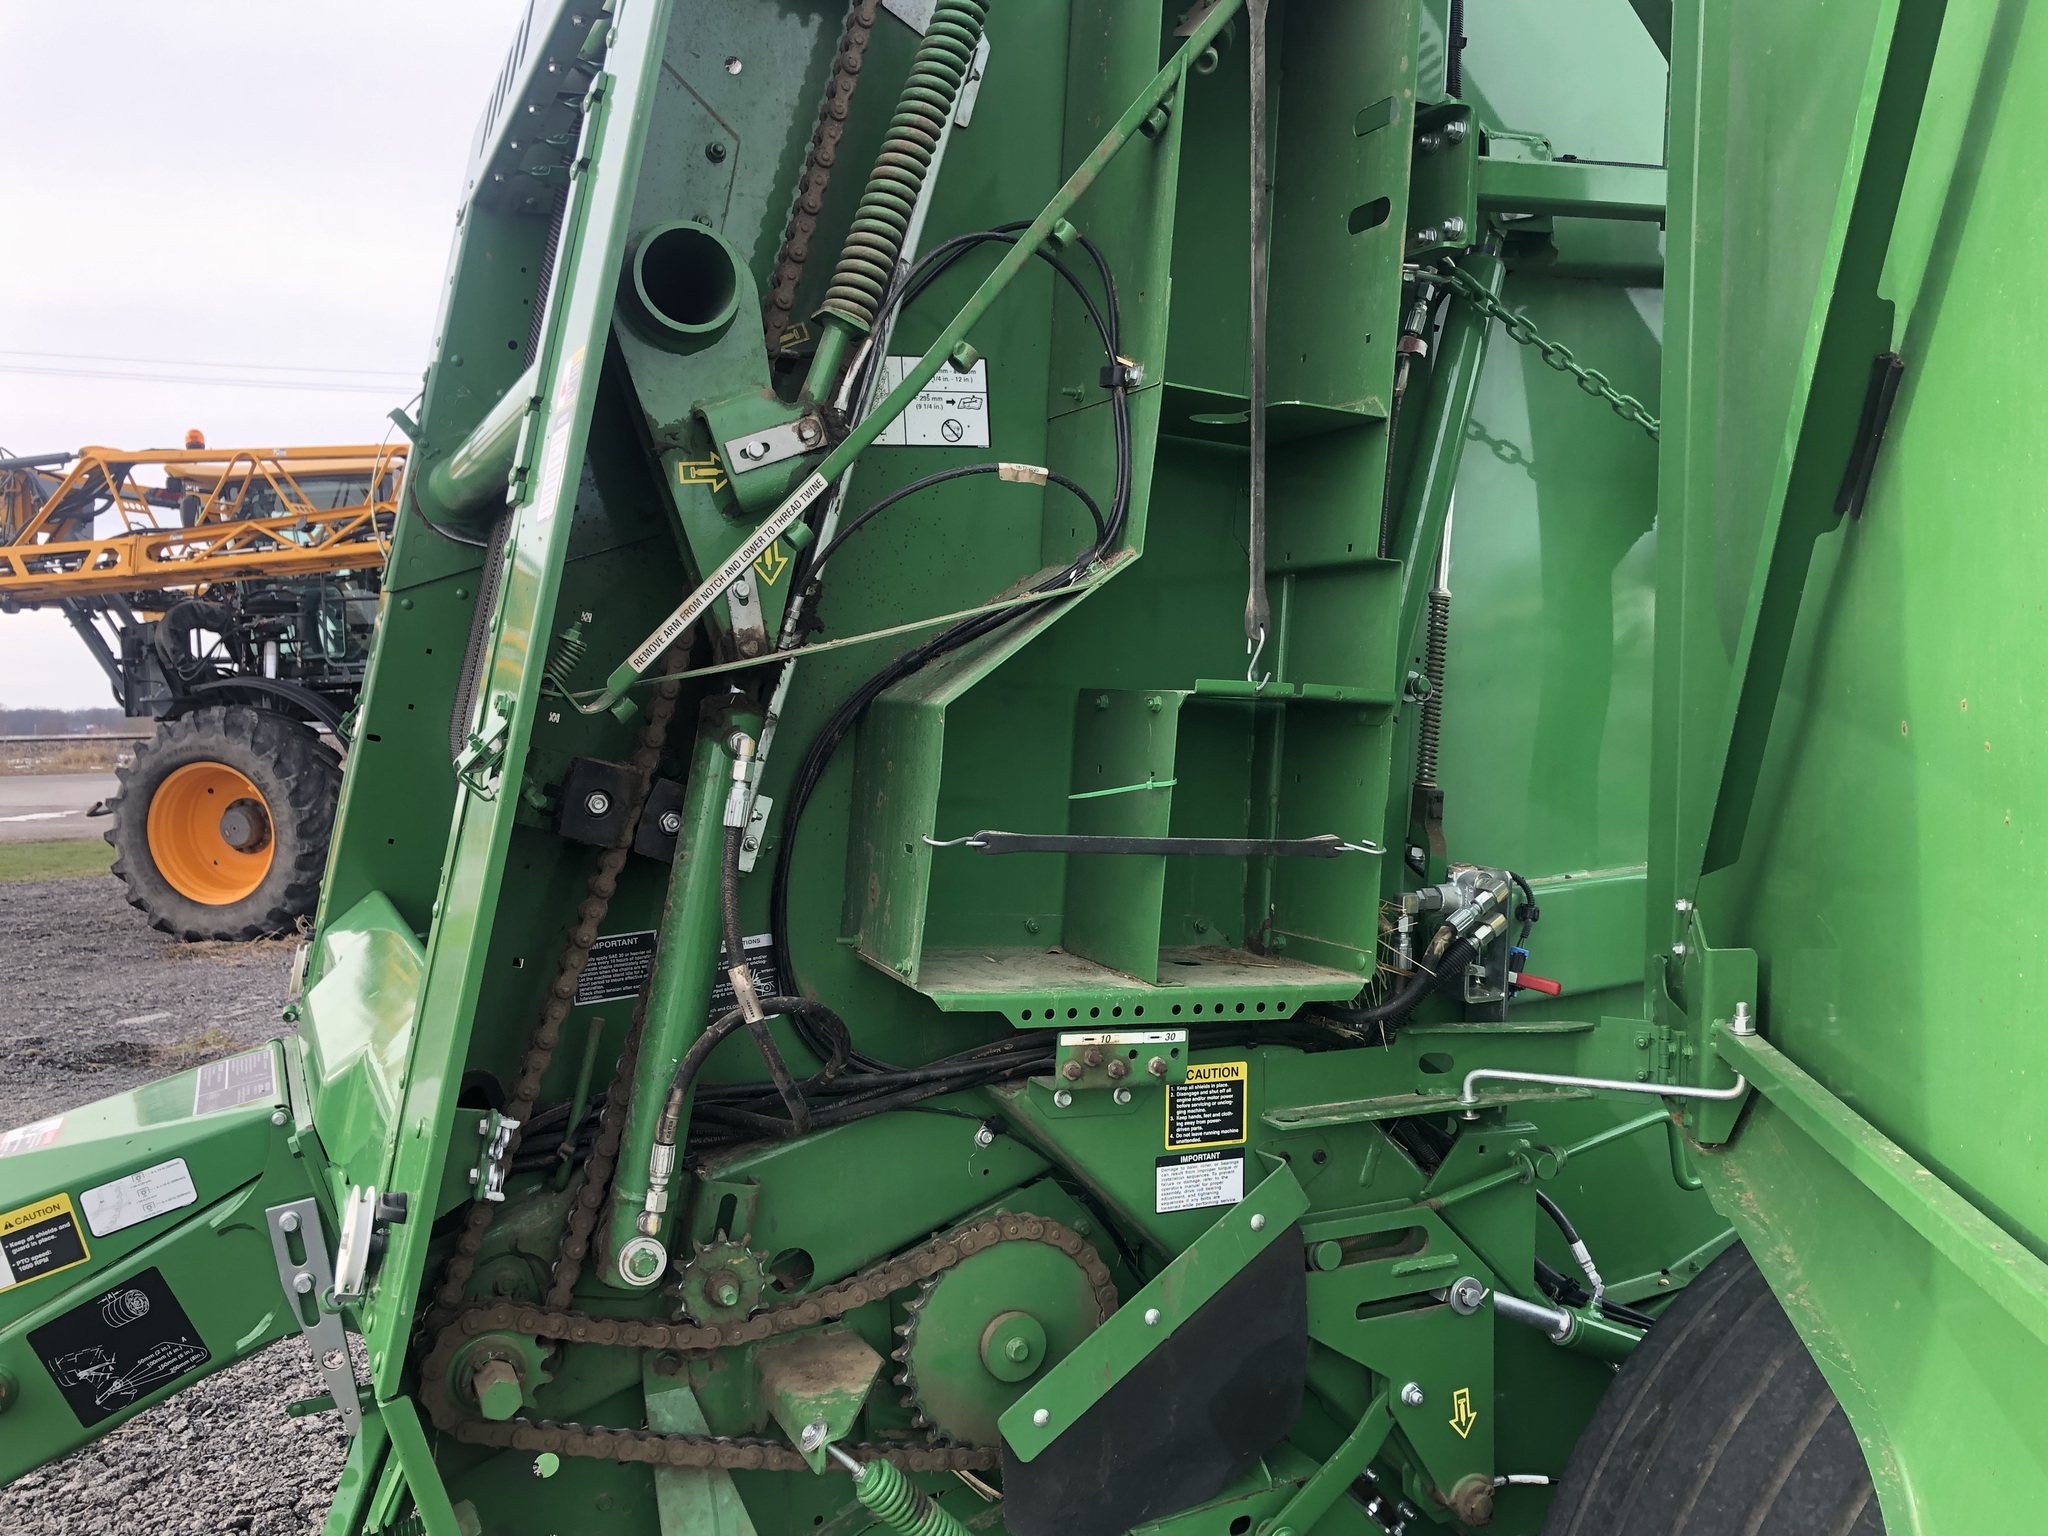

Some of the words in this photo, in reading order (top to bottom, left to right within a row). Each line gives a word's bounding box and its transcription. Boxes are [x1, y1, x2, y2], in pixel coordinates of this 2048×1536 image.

[634, 635, 665, 667] REMOVE
[664, 619, 682, 638] ARM
[680, 598, 703, 621] FROM
[701, 575, 726, 600] NOTCH
[725, 560, 741, 578] AND
[739, 536, 766, 562] LOWER
[763, 526, 775, 538] TO
[773, 500, 801, 527] THREAD
[800, 478, 823, 502] TWINE
[590, 937, 638, 950] MPORTANT
[1102, 1035, 1111, 1043] 10
[1165, 1033, 1176, 1041] 30
[1186, 1067, 1238, 1080] CAUTION
[1181, 1152, 1220, 1163] IMPORTANT
[15, 1203, 60, 1225] CAUTION
[9, 1239, 26, 1248] Keep
[35, 1228, 58, 1238] shields
[59, 1222, 70, 1230] and
[12, 1243, 30, 1254] guard
[38, 1235, 57, 1245] place.
[16, 1258, 30, 1266] PTO
[31, 1250, 52, 1262] speed:
[19, 1263, 33, 1271] 1000
[34, 1257, 49, 1266] RPM
